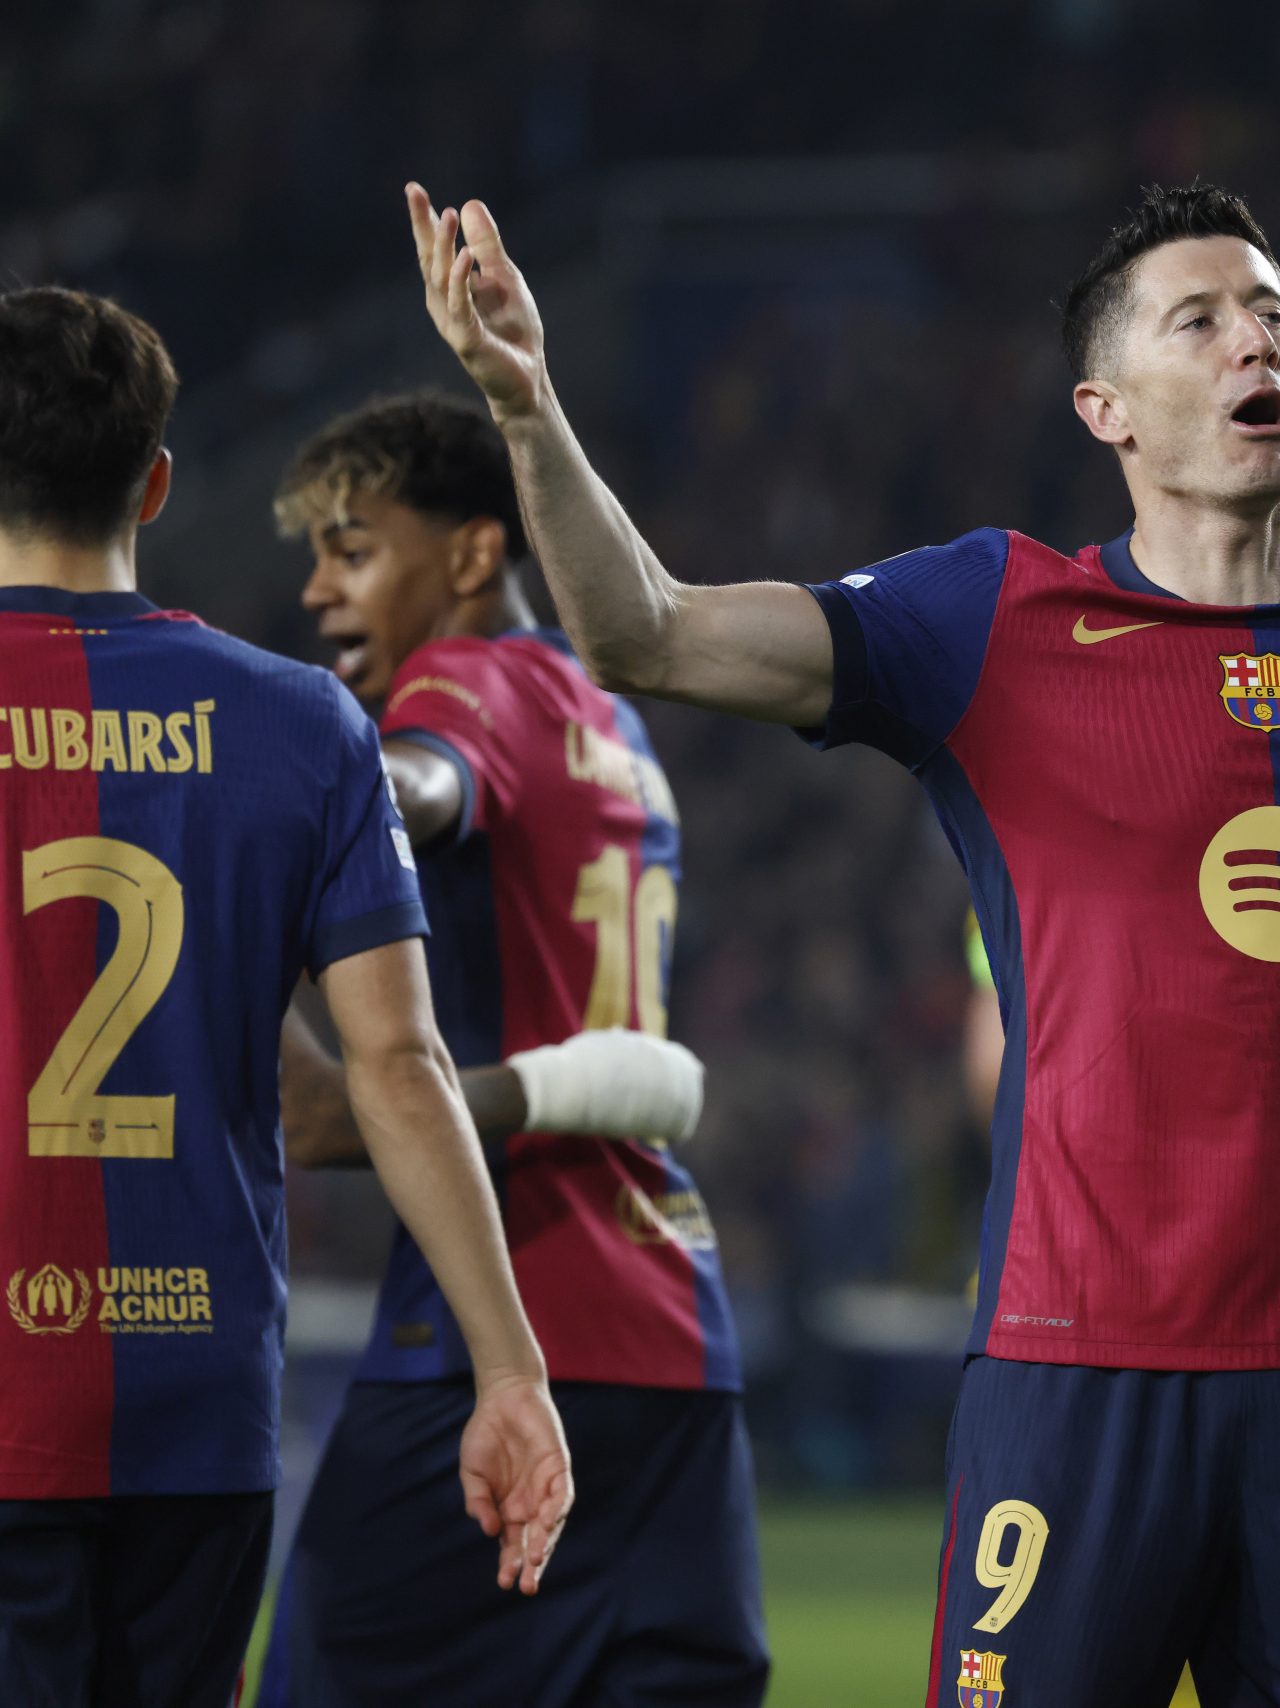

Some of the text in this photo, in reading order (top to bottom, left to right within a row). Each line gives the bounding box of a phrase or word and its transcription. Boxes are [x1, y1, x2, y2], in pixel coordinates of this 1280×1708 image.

[1244, 687, 1276, 697] FCB
[570, 843, 679, 1040] 10
[22, 836, 185, 1159] 2
[97, 1267, 210, 1294] UNHCR
[97, 1295, 213, 1322] ACNUR
[971, 1499, 1050, 1634] 9
[970, 1678, 988, 1689] FCB
